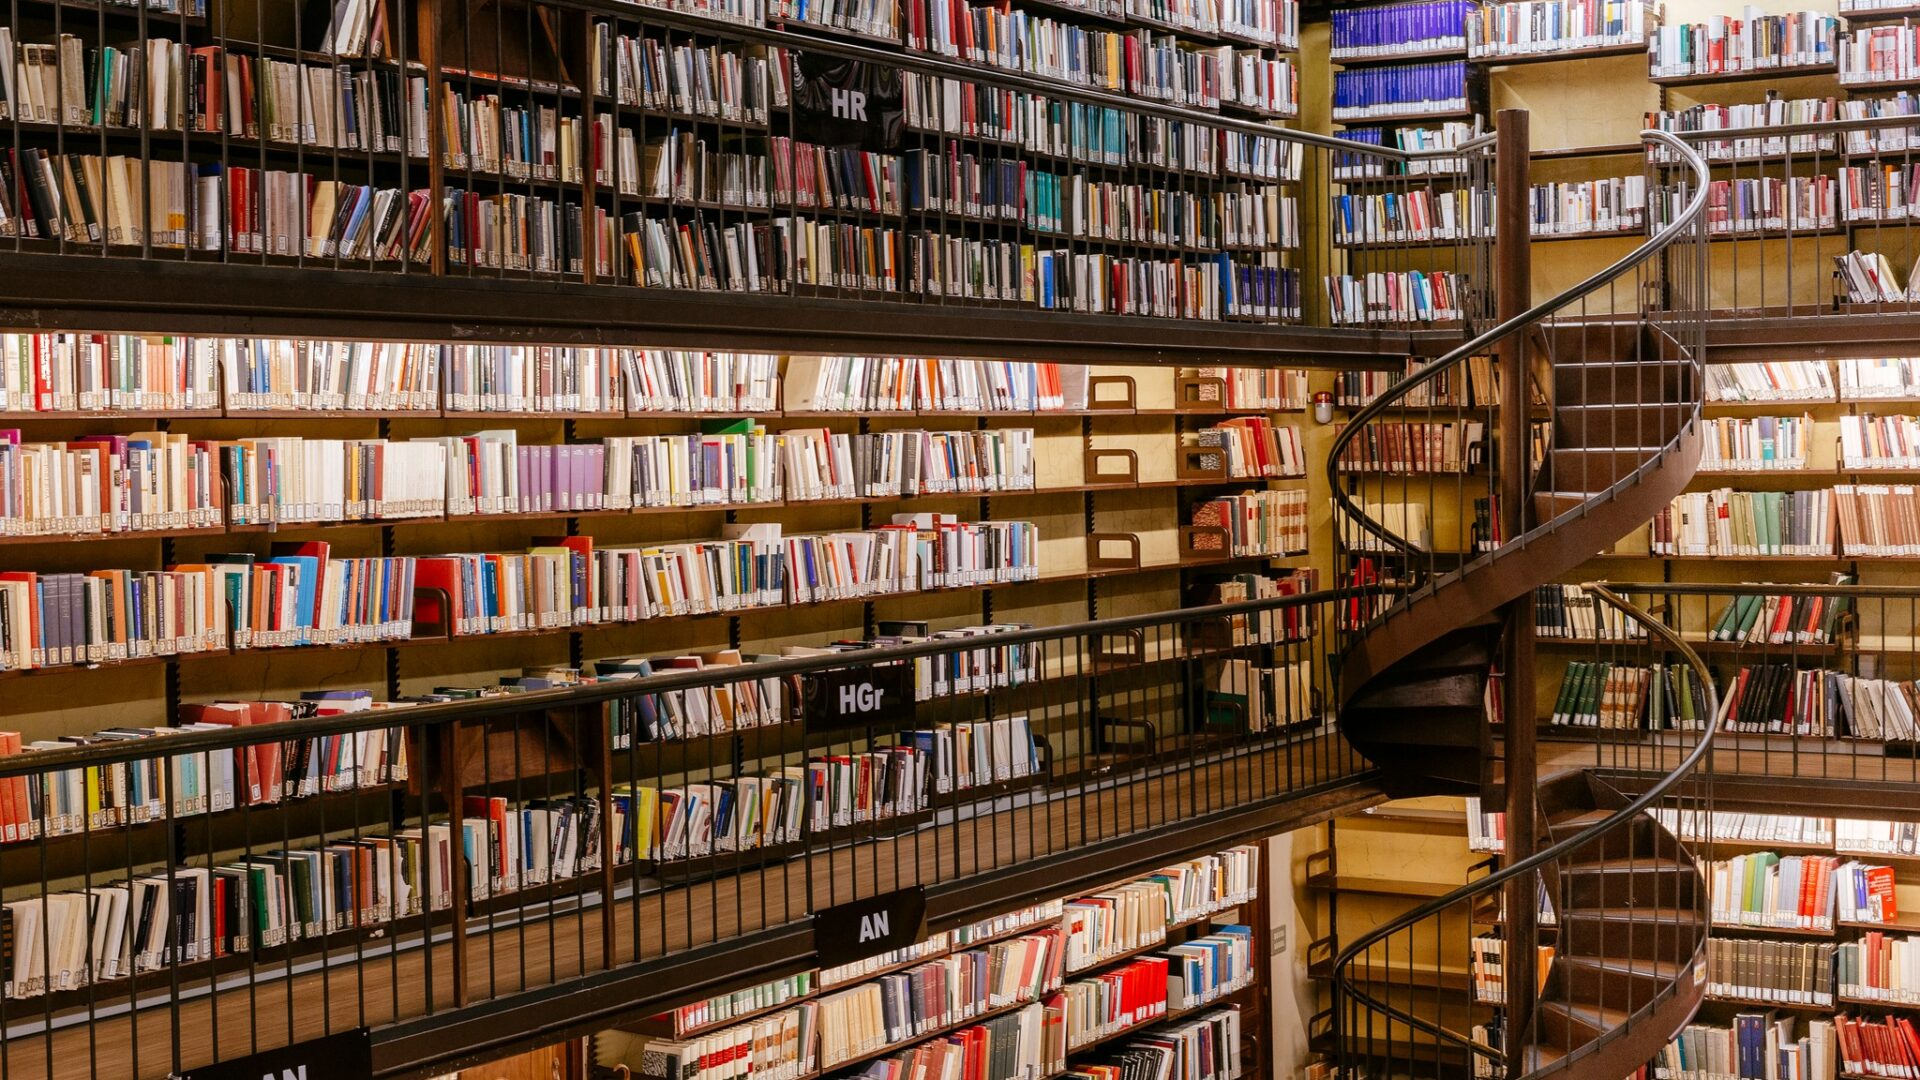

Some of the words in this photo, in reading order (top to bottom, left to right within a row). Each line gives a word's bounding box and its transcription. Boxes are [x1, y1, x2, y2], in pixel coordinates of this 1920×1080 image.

[832, 88, 868, 122] HR
[839, 682, 885, 715] HGr
[859, 910, 890, 943] AN
